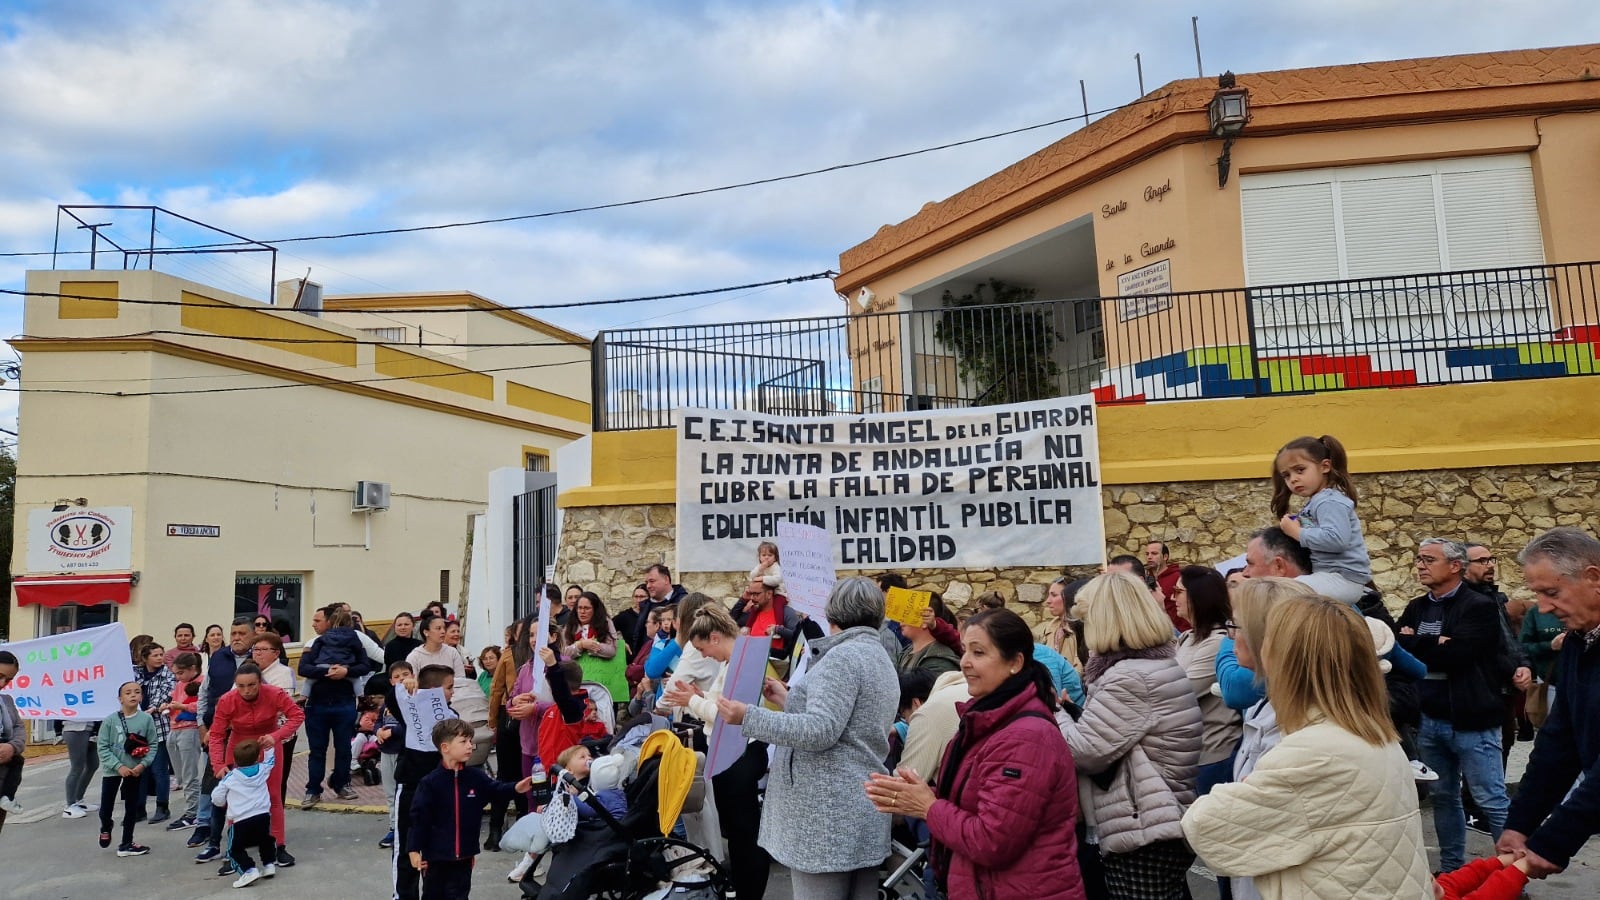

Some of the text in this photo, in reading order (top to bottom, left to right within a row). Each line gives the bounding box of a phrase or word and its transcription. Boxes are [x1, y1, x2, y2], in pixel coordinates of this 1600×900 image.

[1102, 200, 1127, 219] Santo
[1105, 237, 1176, 271] de la Guarda
[1131, 263, 1167, 281] ANIVERSARIO
[850, 418, 940, 443] ÁNGEL
[946, 425, 966, 440] DE
[971, 423, 991, 437] LA
[996, 405, 1093, 435] GUARDA
[701, 434, 1083, 475] LA JUNTA DE ANDALUCÍA NO
[700, 461, 1098, 504] CUBRE LA FALTA DE PERSONAL
[48, 543, 111, 558] Francisco Javier
[253, 576, 263, 584] de
[26, 641, 92, 663] OLIVO
[41, 672, 54, 687] A
[63, 664, 104, 684] UNA
[64, 690, 95, 706] DE
